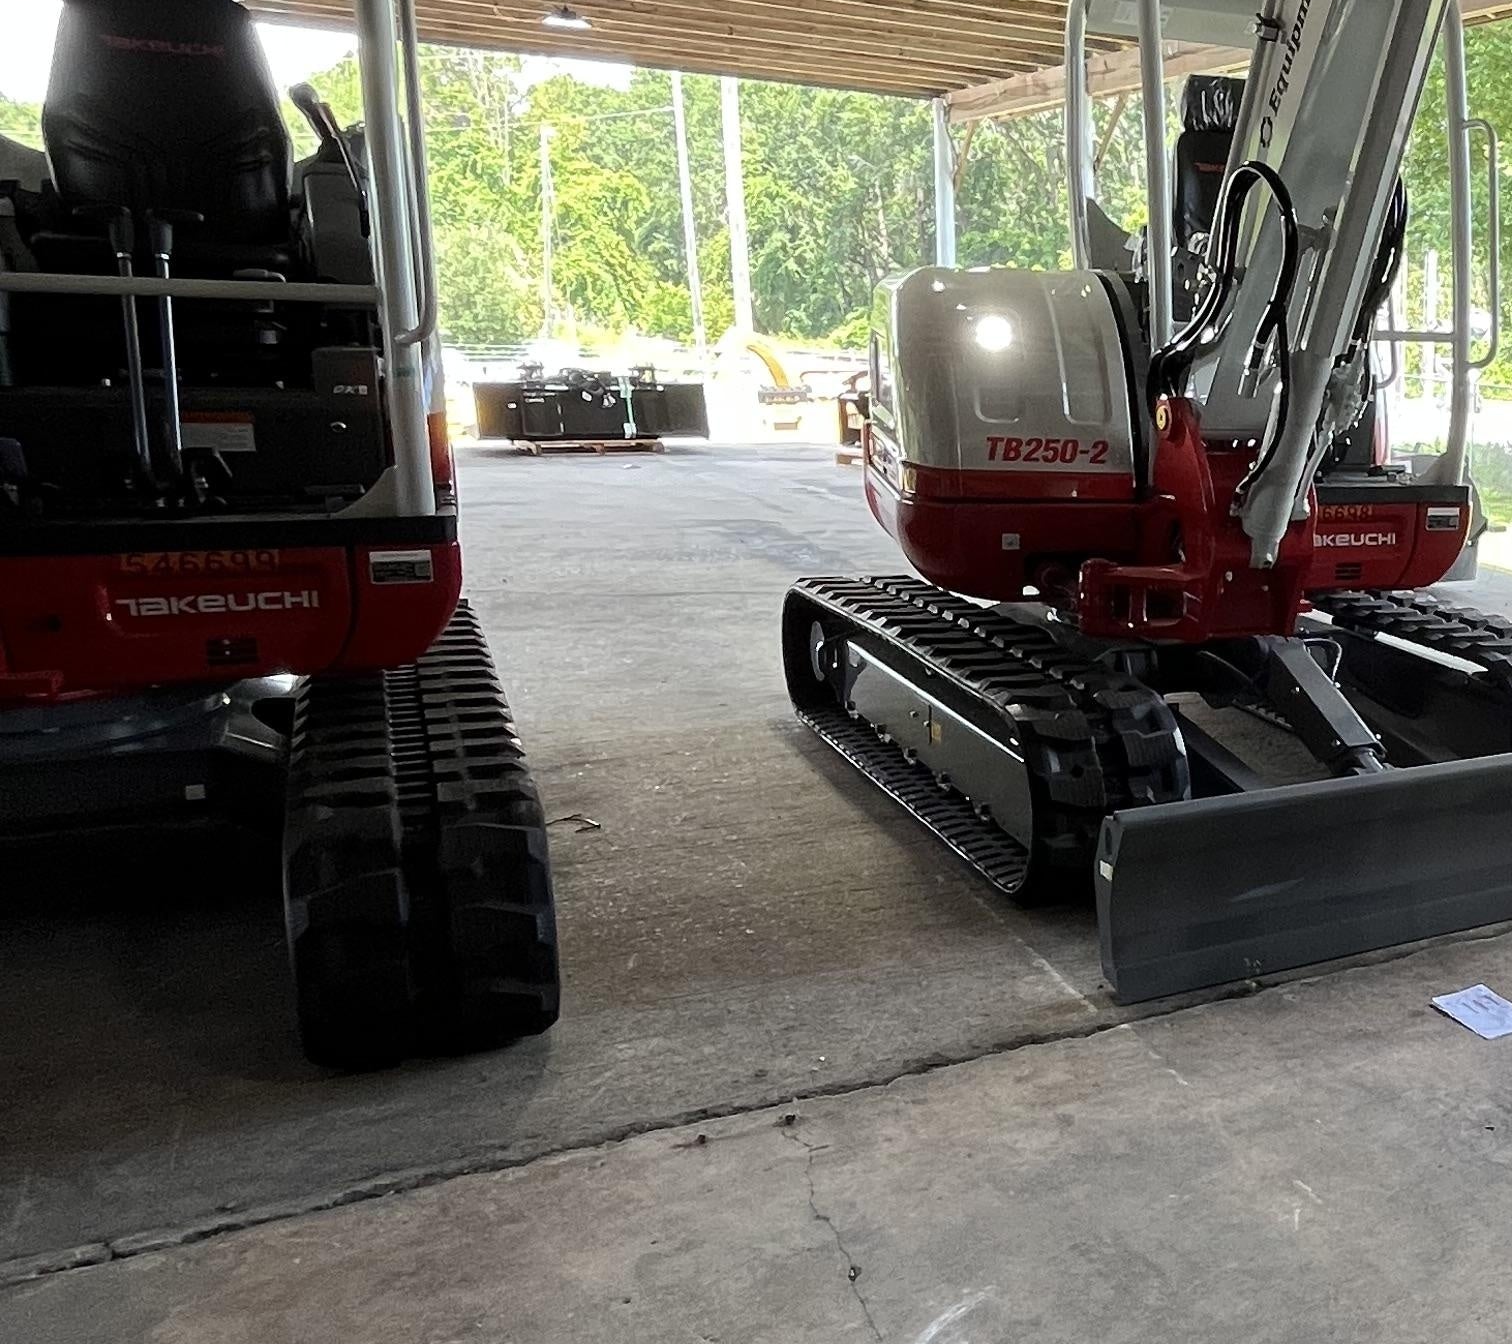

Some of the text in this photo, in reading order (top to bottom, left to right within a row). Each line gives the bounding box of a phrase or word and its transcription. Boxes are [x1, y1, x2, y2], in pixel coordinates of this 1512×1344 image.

[986, 435, 1110, 465] TB250-2
[1322, 505, 1370, 521] 6698
[1313, 531, 1396, 548] AKEUCHI
[114, 589, 320, 618] TAKEUCHI
